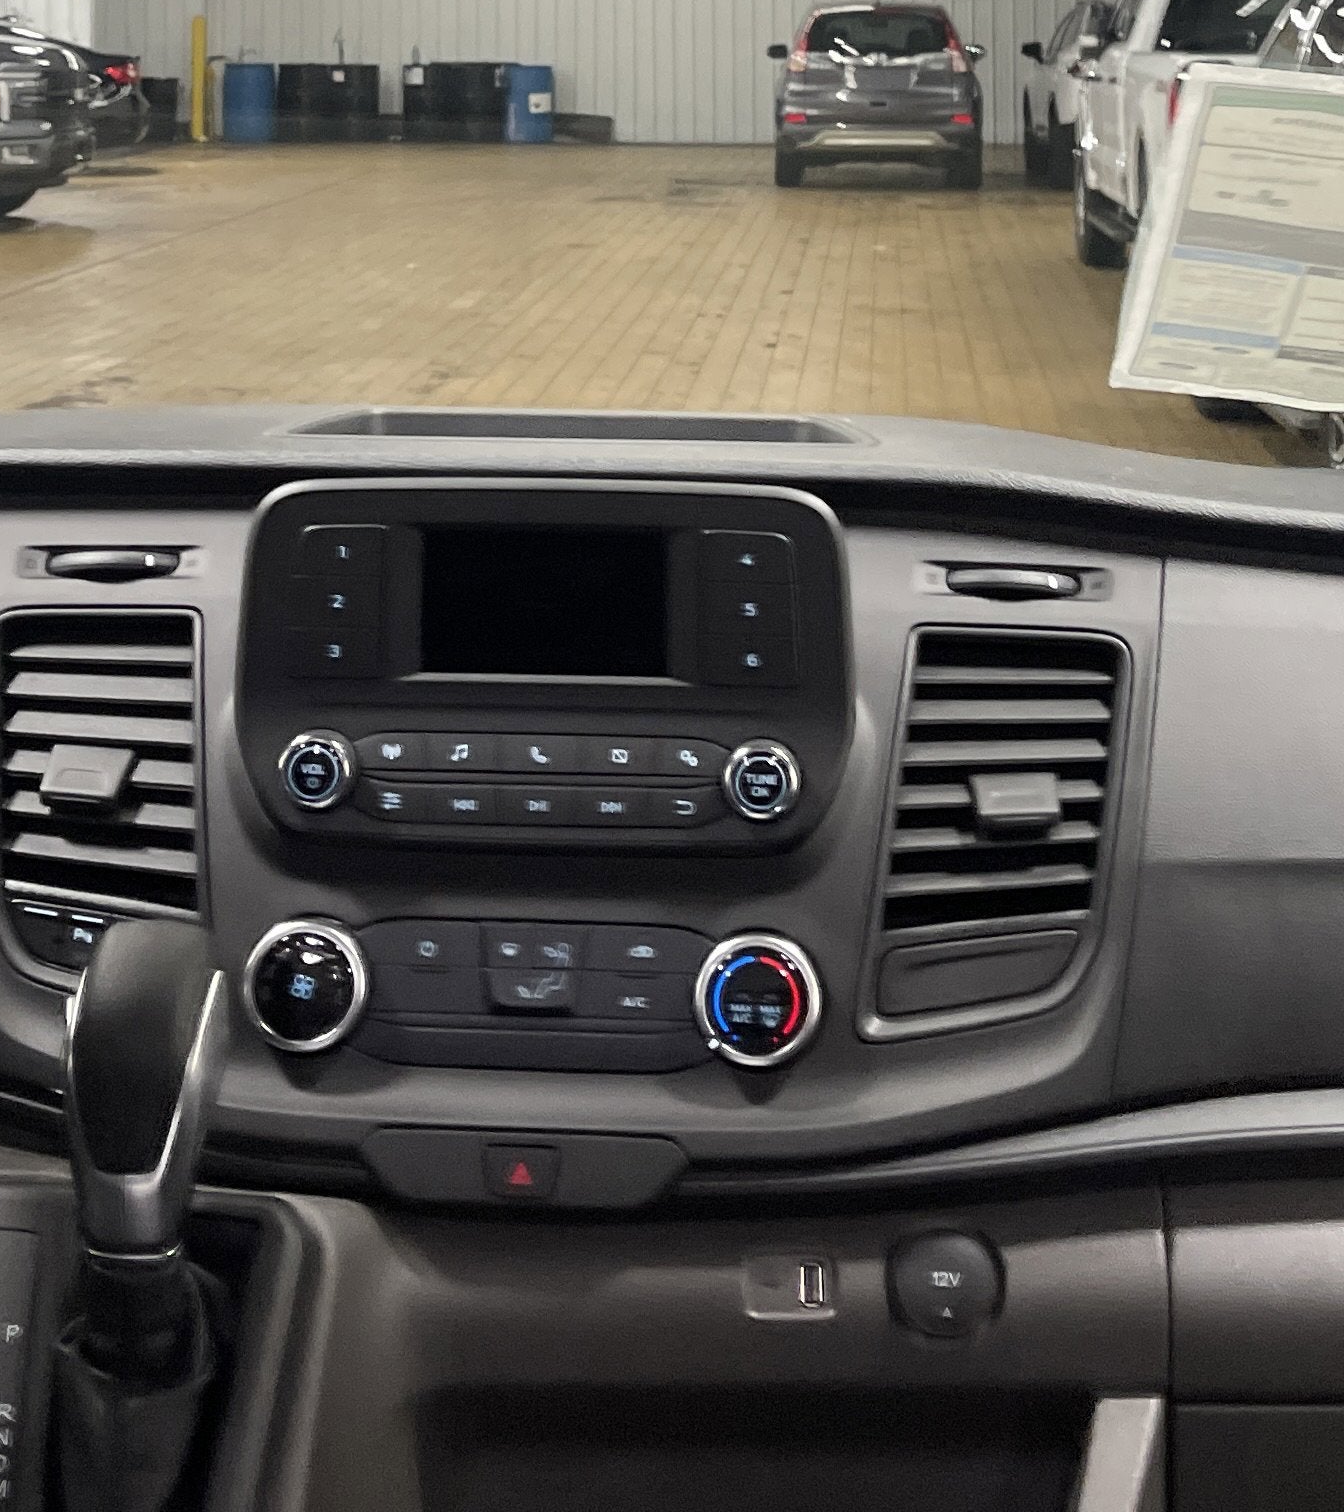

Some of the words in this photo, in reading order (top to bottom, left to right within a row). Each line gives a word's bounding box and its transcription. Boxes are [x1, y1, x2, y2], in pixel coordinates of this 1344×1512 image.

[330, 594, 345, 608] 2
[742, 602, 758, 617] 5
[746, 653, 761, 667] 6
[931, 1271, 961, 1288] 12V
[5, 1324, 21, 1343] P
